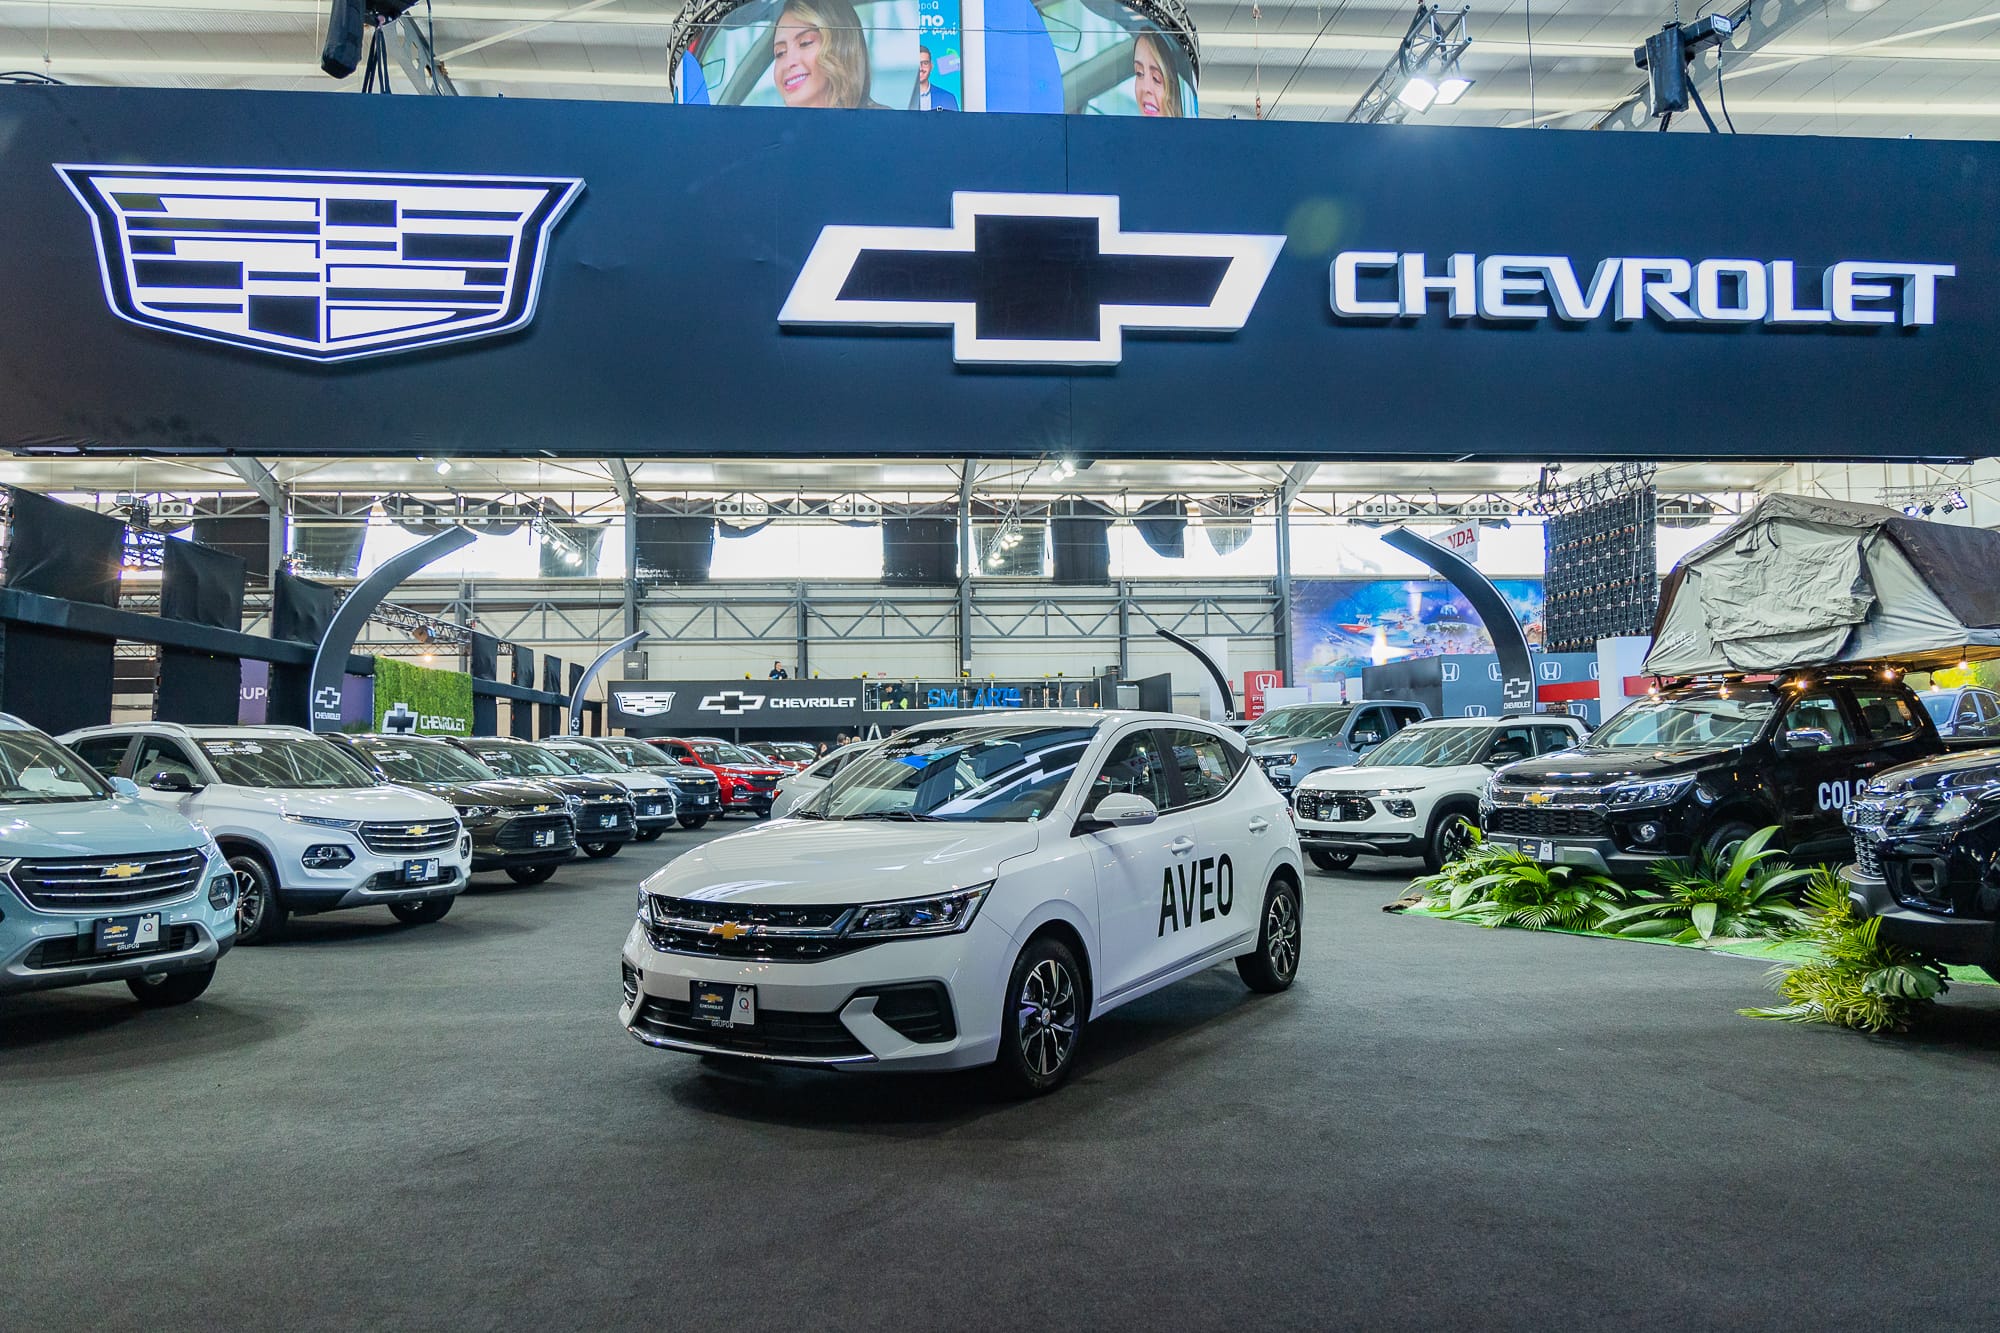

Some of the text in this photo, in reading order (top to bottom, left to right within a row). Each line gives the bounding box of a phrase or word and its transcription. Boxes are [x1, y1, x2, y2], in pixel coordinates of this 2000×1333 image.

[919, 1, 939, 10] poQ
[1330, 251, 1956, 326] CHEVROLET
[240, 687, 268, 700] UP
[769, 697, 856, 708] CHEVROLET
[420, 714, 466, 732] CHEVROLET
[1158, 853, 1234, 938] AVEO
